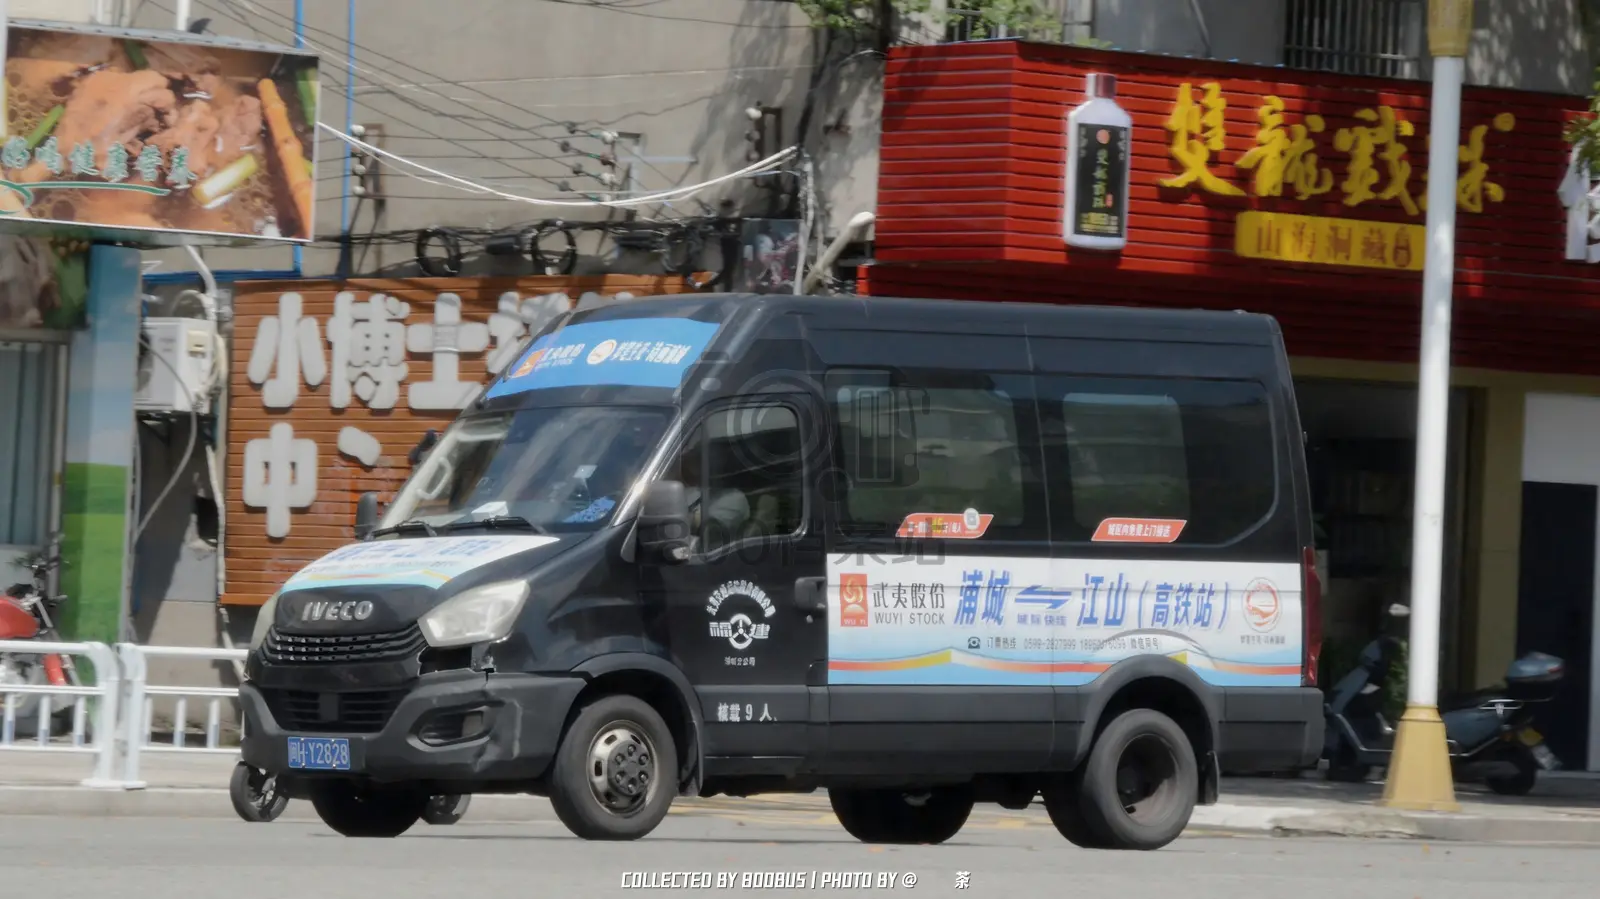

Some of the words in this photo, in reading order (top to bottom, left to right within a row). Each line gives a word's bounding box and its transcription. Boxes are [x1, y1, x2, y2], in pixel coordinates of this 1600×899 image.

[244, 422, 381, 538] 中
[872, 582, 945, 609] 武夷股份
[954, 569, 1011, 626] 浦城
[301, 600, 374, 621] IVECO
[875, 612, 903, 625] WUYI
[909, 612, 945, 625] STOCK
